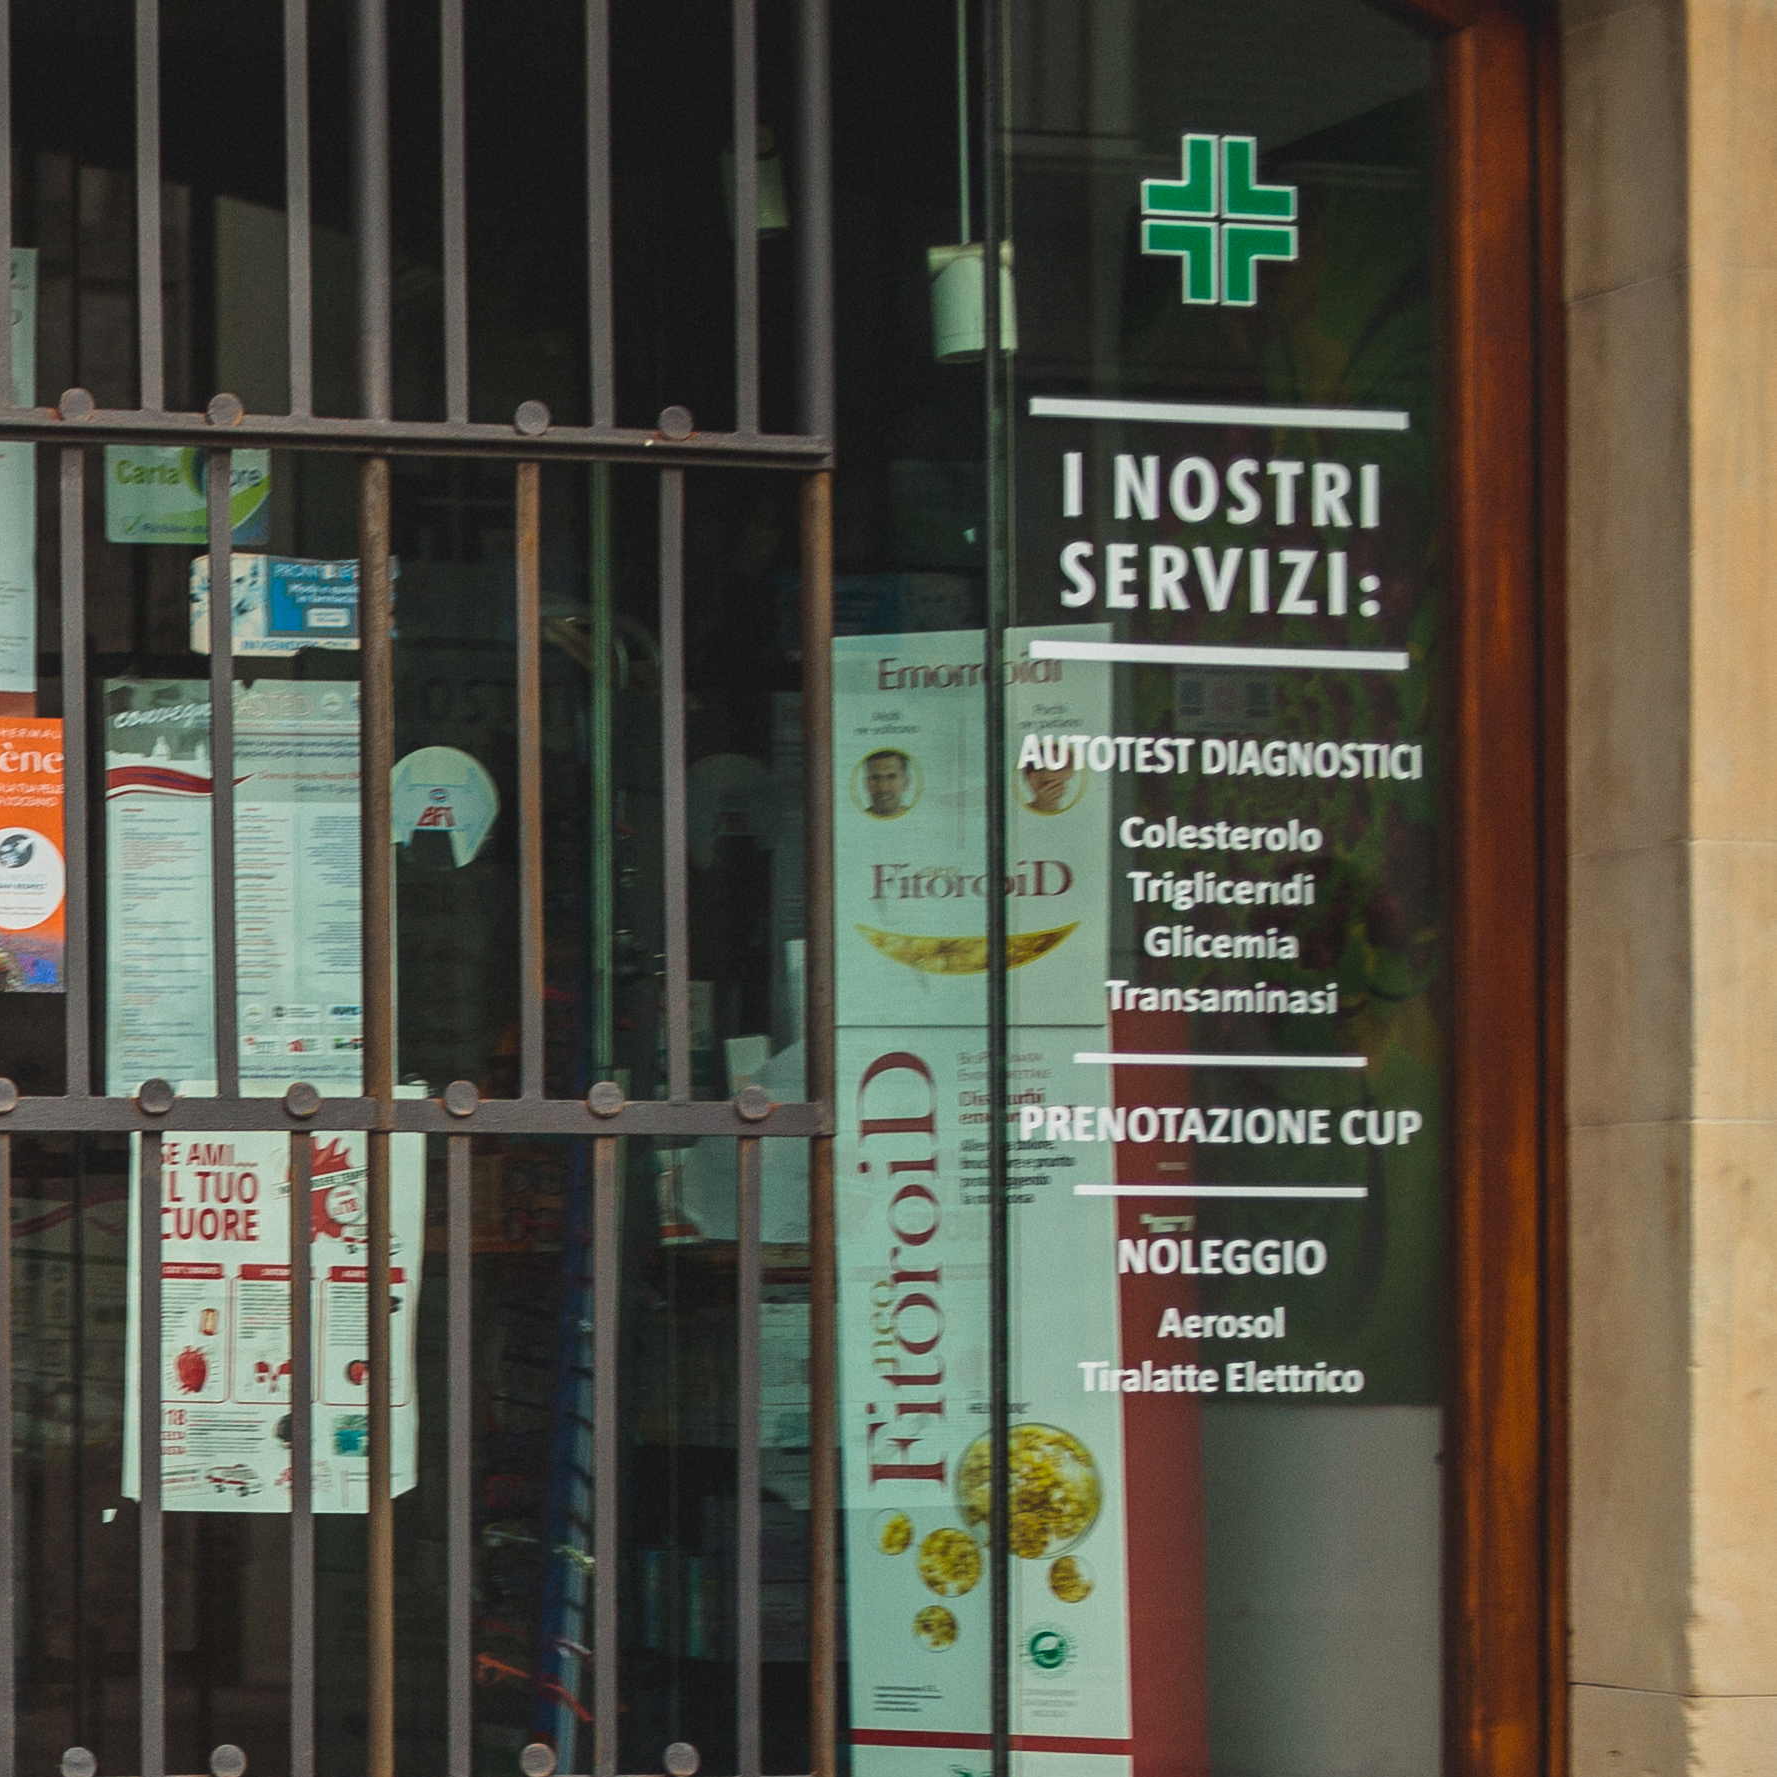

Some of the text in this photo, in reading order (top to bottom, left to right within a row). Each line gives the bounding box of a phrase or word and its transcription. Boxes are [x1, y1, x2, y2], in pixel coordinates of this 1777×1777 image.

[115, 457, 182, 487] Carta
[1062, 452, 1380, 529] I NOSTRI
[1059, 541, 1380, 618] SERVIZI:
[1017, 733, 1423, 781] AUTOTEST DIAGNOSTICI
[1120, 816, 1323, 853] Colesterolo
[1126, 870, 1315, 910] Trigliceridi
[1144, 925, 1299, 960] Glicemia
[1104, 979, 1338, 1014] Transaminasi
[1019, 1105, 1422, 1146] PRENOTAZIONE CUP
[167, 1170, 261, 1205] L TUO
[856, 1051, 947, 1493] FitoroiD
[1118, 1239, 1327, 1277] NOLEGGIO
[1157, 1306, 1285, 1339] Aerosol
[1077, 1362, 1365, 1395] Tiralatte Elettrico
